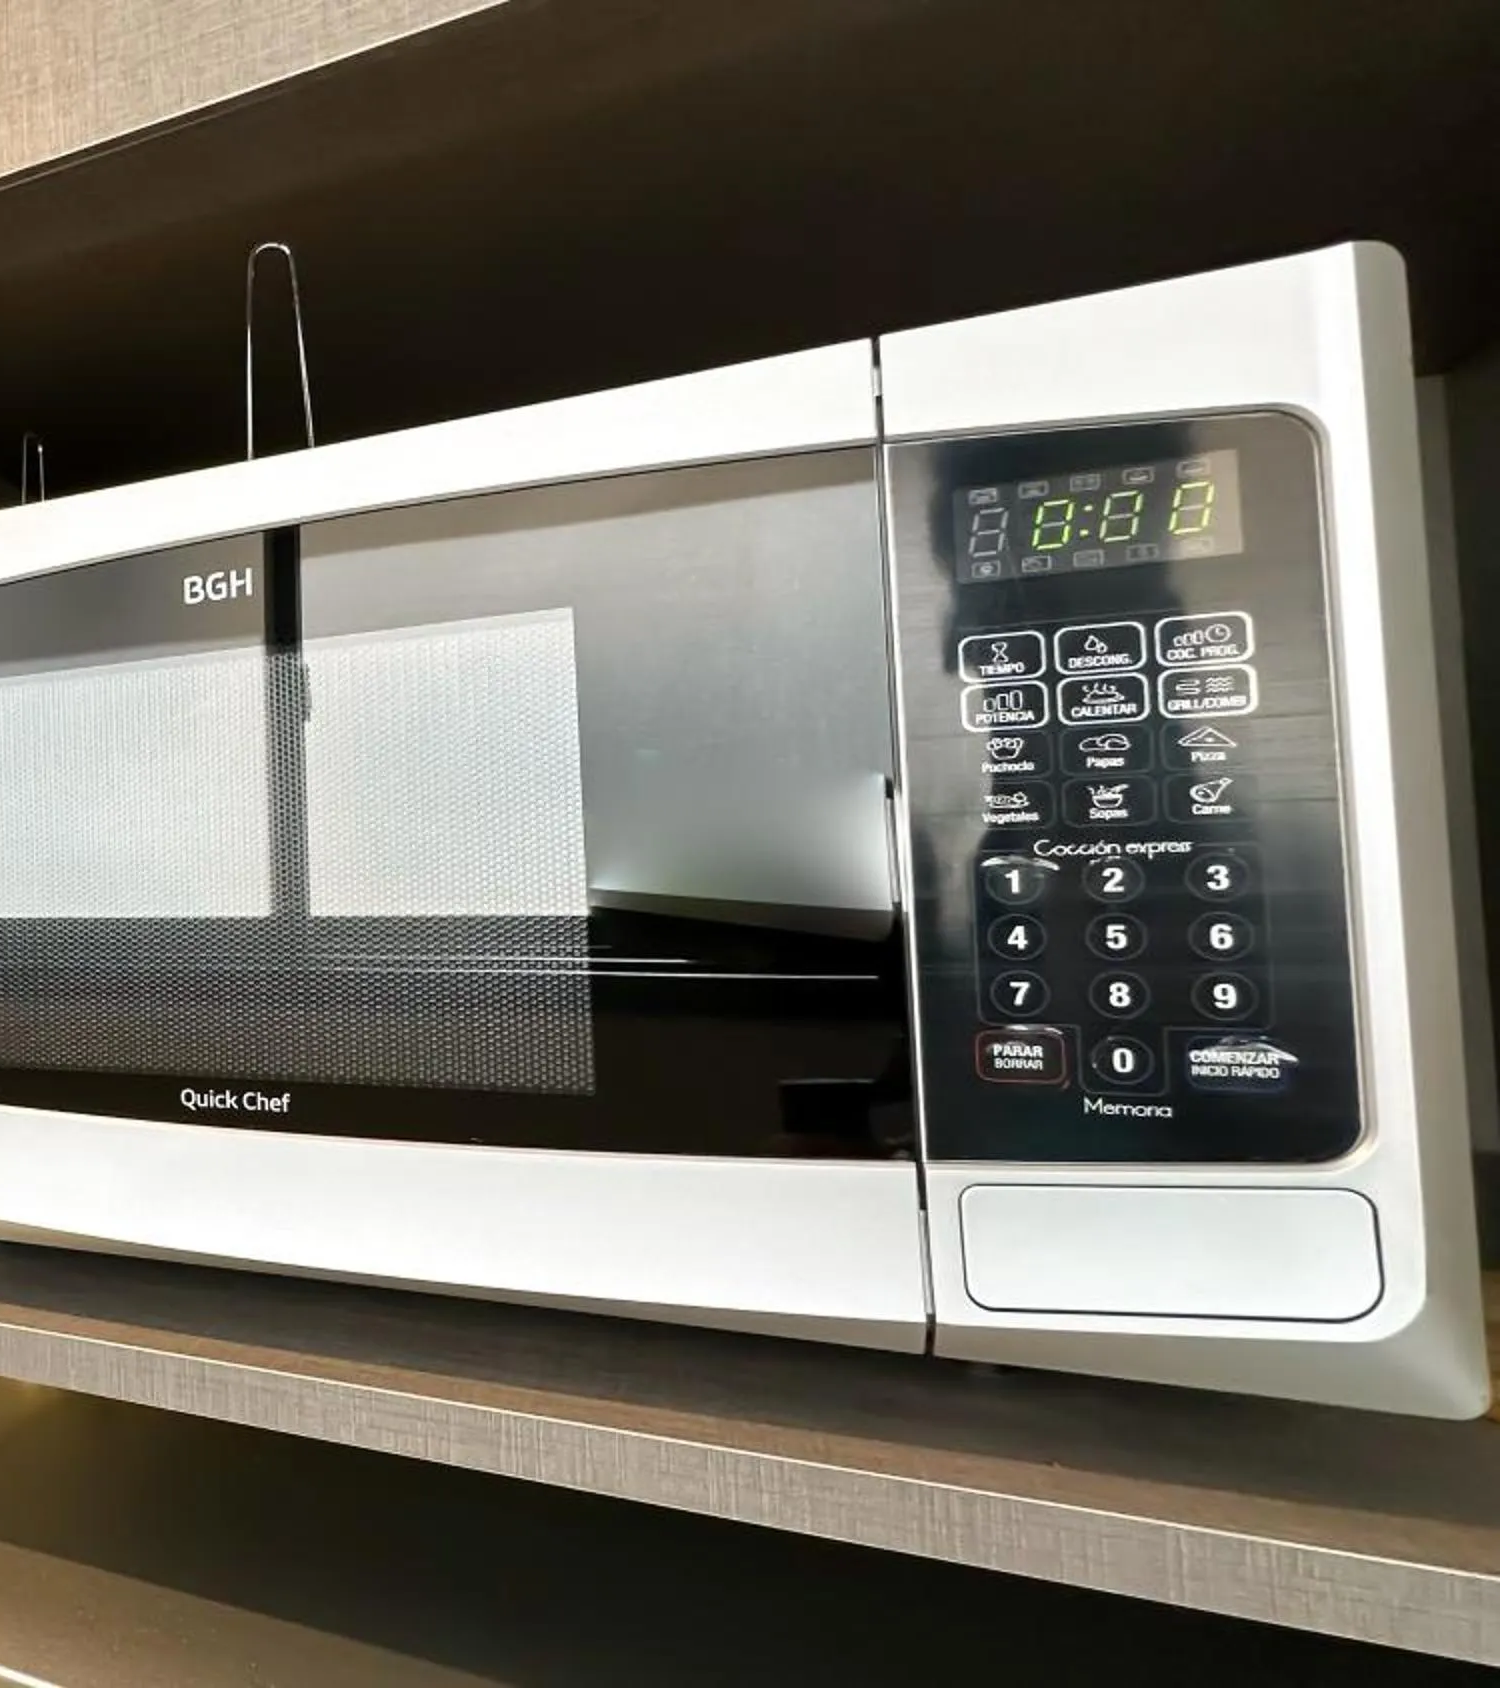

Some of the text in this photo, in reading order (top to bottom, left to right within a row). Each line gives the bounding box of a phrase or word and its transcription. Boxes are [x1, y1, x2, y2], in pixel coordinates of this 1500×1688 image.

[183, 567, 253, 604] BGH
[979, 662, 1025, 676] TIEMPO
[1068, 655, 1132, 669] DESCONG.
[975, 710, 1035, 725] POTENCIA
[1071, 703, 1137, 718] CALENTAR
[1086, 756, 1125, 769] Papas
[1191, 751, 1227, 762] Pizza
[982, 811, 1040, 825] Vegetales
[1089, 807, 1129, 820] Sopas
[1191, 803, 1232, 815] Carne
[1033, 839, 1192, 859] Cocción express
[1004, 870, 1021, 894] 1
[1102, 867, 1125, 893] 2
[1206, 865, 1230, 890] 3
[1007, 926, 1028, 950] 4
[1105, 925, 1128, 950] 5
[1209, 924, 1234, 950] 6
[1009, 981, 1031, 1006] 7
[1108, 982, 1131, 1008] 8
[1213, 983, 1238, 1010] 9
[993, 1044, 1043, 1058] PARAR
[1111, 1048, 1134, 1073] 0
[1189, 1049, 1279, 1065] COMENZAR
[994, 1056, 1043, 1070] BORRAR
[1191, 1064, 1229, 1077] INICIO
[180, 1087, 291, 1113] Quick Chef
[1084, 1098, 1173, 1118] Memoria
